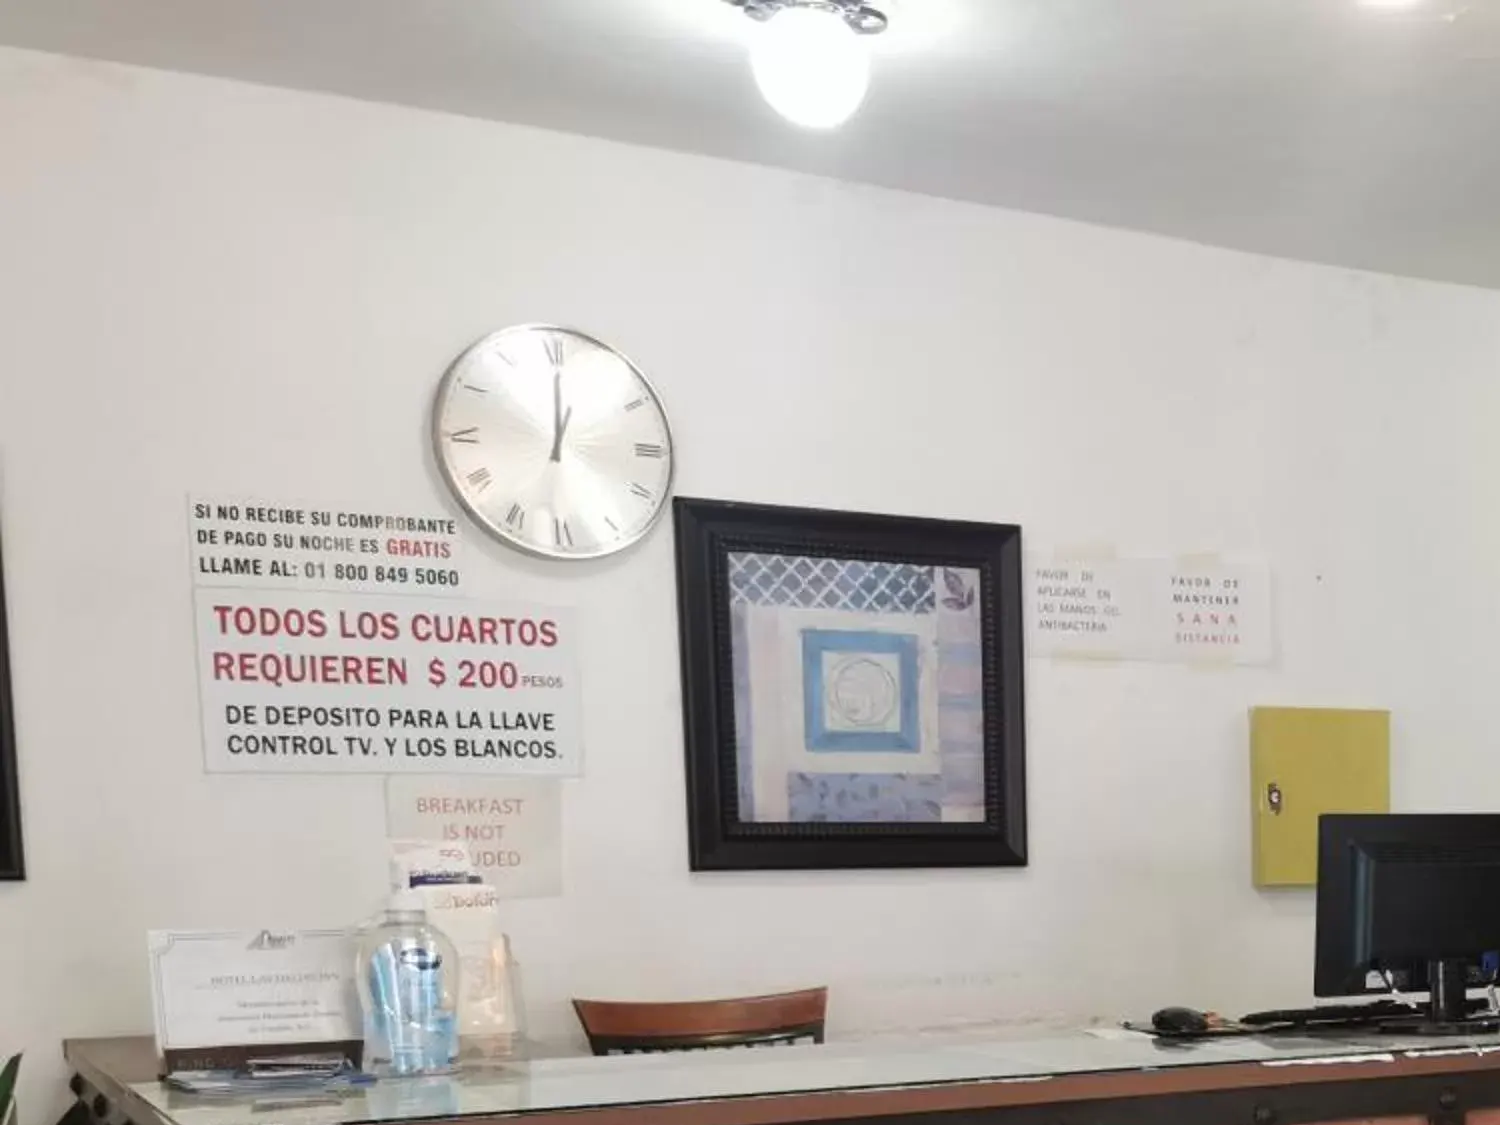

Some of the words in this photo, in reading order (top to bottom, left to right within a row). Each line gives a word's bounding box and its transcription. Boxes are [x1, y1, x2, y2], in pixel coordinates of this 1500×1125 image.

[196, 503, 211, 519] SI
[217, 506, 239, 522] NO
[246, 508, 305, 526] RECIBE
[311, 511, 331, 527] SU
[337, 514, 456, 535] COMPROBANTE
[197, 529, 216, 545] DE
[224, 531, 267, 548] PAGO
[273, 534, 294, 550] SU
[300, 536, 356, 553] NOCHE
[360, 538, 380, 554] ES
[386, 538, 452, 558] GRATIS
[199, 557, 263, 577] LLAME
[269, 560, 298, 578] AL:
[305, 562, 326, 579] 01
[335, 564, 369, 582] 800
[375, 565, 408, 584] 849
[415, 568, 460, 586] 5060
[1171, 576, 1211, 588] FAVOR
[1223, 579, 1238, 589] DE
[1173, 593, 1239, 605] MANTENER
[213, 605, 327, 639] TODOS
[339, 610, 399, 641] LOS
[411, 613, 558, 648] CUARTOS
[213, 652, 408, 687] REQUIEREN
[428, 657, 446, 689] $
[458, 660, 517, 689] 200
[521, 675, 564, 689] PESOS
[225, 705, 257, 726] DE
[265, 706, 381, 729] DEPOSITO
[389, 708, 449, 730] PARA
[456, 710, 483, 730] LA
[490, 712, 556, 732] LLAVE
[227, 736, 338, 756] CONTROL
[384, 738, 397, 756] Y
[405, 738, 447, 757] LOS
[454, 739, 564, 760] BLANCOS.
[416, 797, 525, 815] BREAKFAST
[443, 824, 460, 841] IS
[465, 825, 506, 841] NOT
